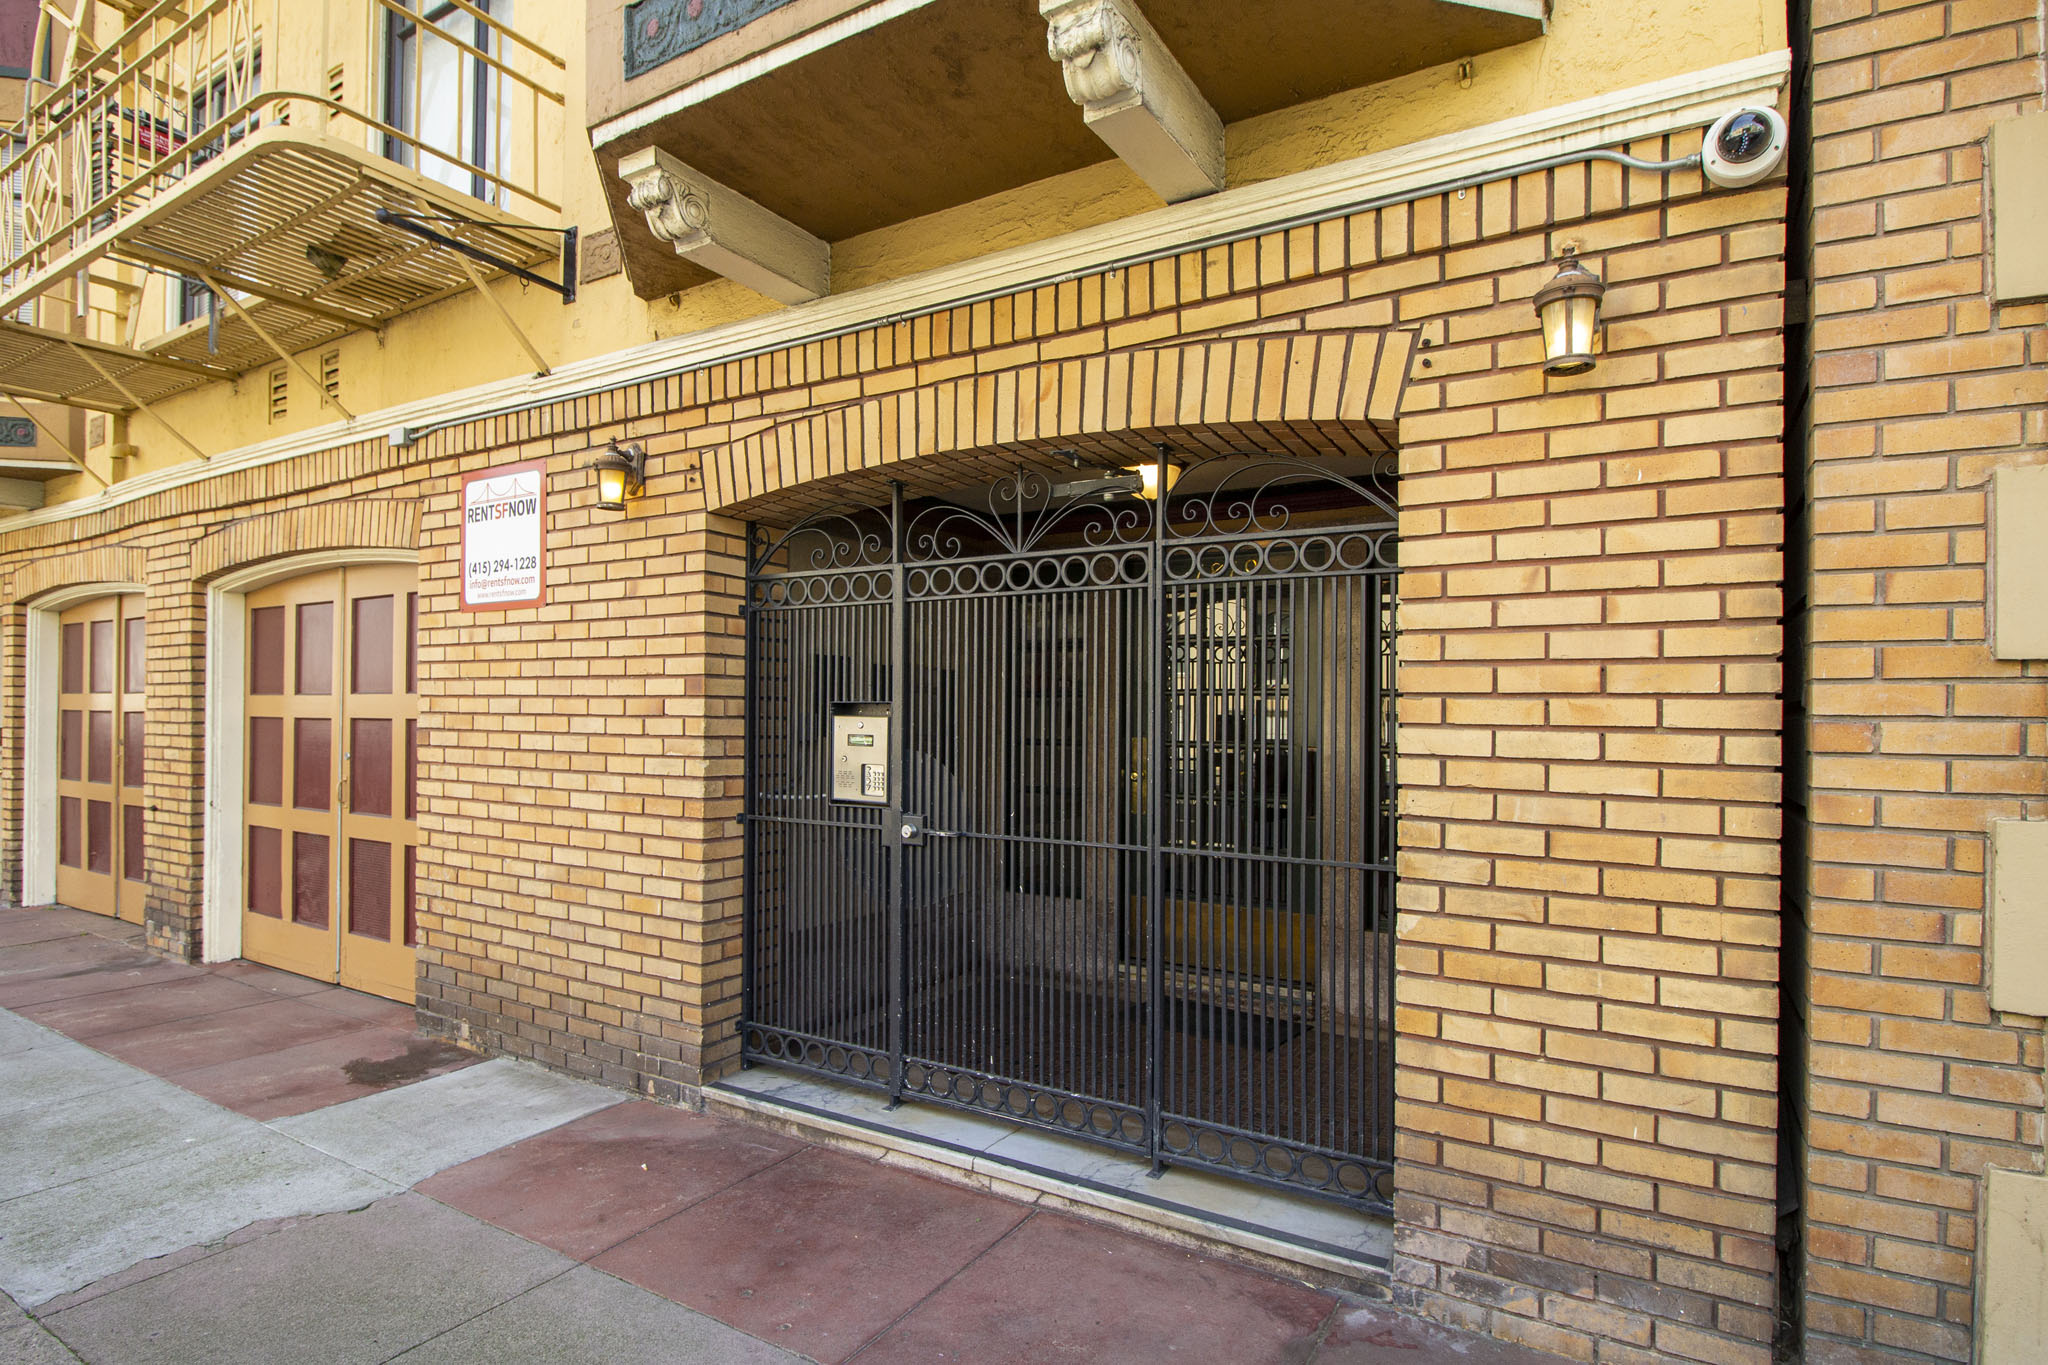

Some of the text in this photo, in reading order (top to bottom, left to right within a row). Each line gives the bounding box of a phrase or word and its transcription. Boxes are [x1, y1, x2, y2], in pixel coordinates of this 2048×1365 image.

[468, 498, 537, 523] RENTSFNOW
[469, 556, 537, 578] (415) 294-1228
[469, 575, 535, 589] info@rentsfnow.com
[477, 588, 527, 599] www.rentsfnow.com
